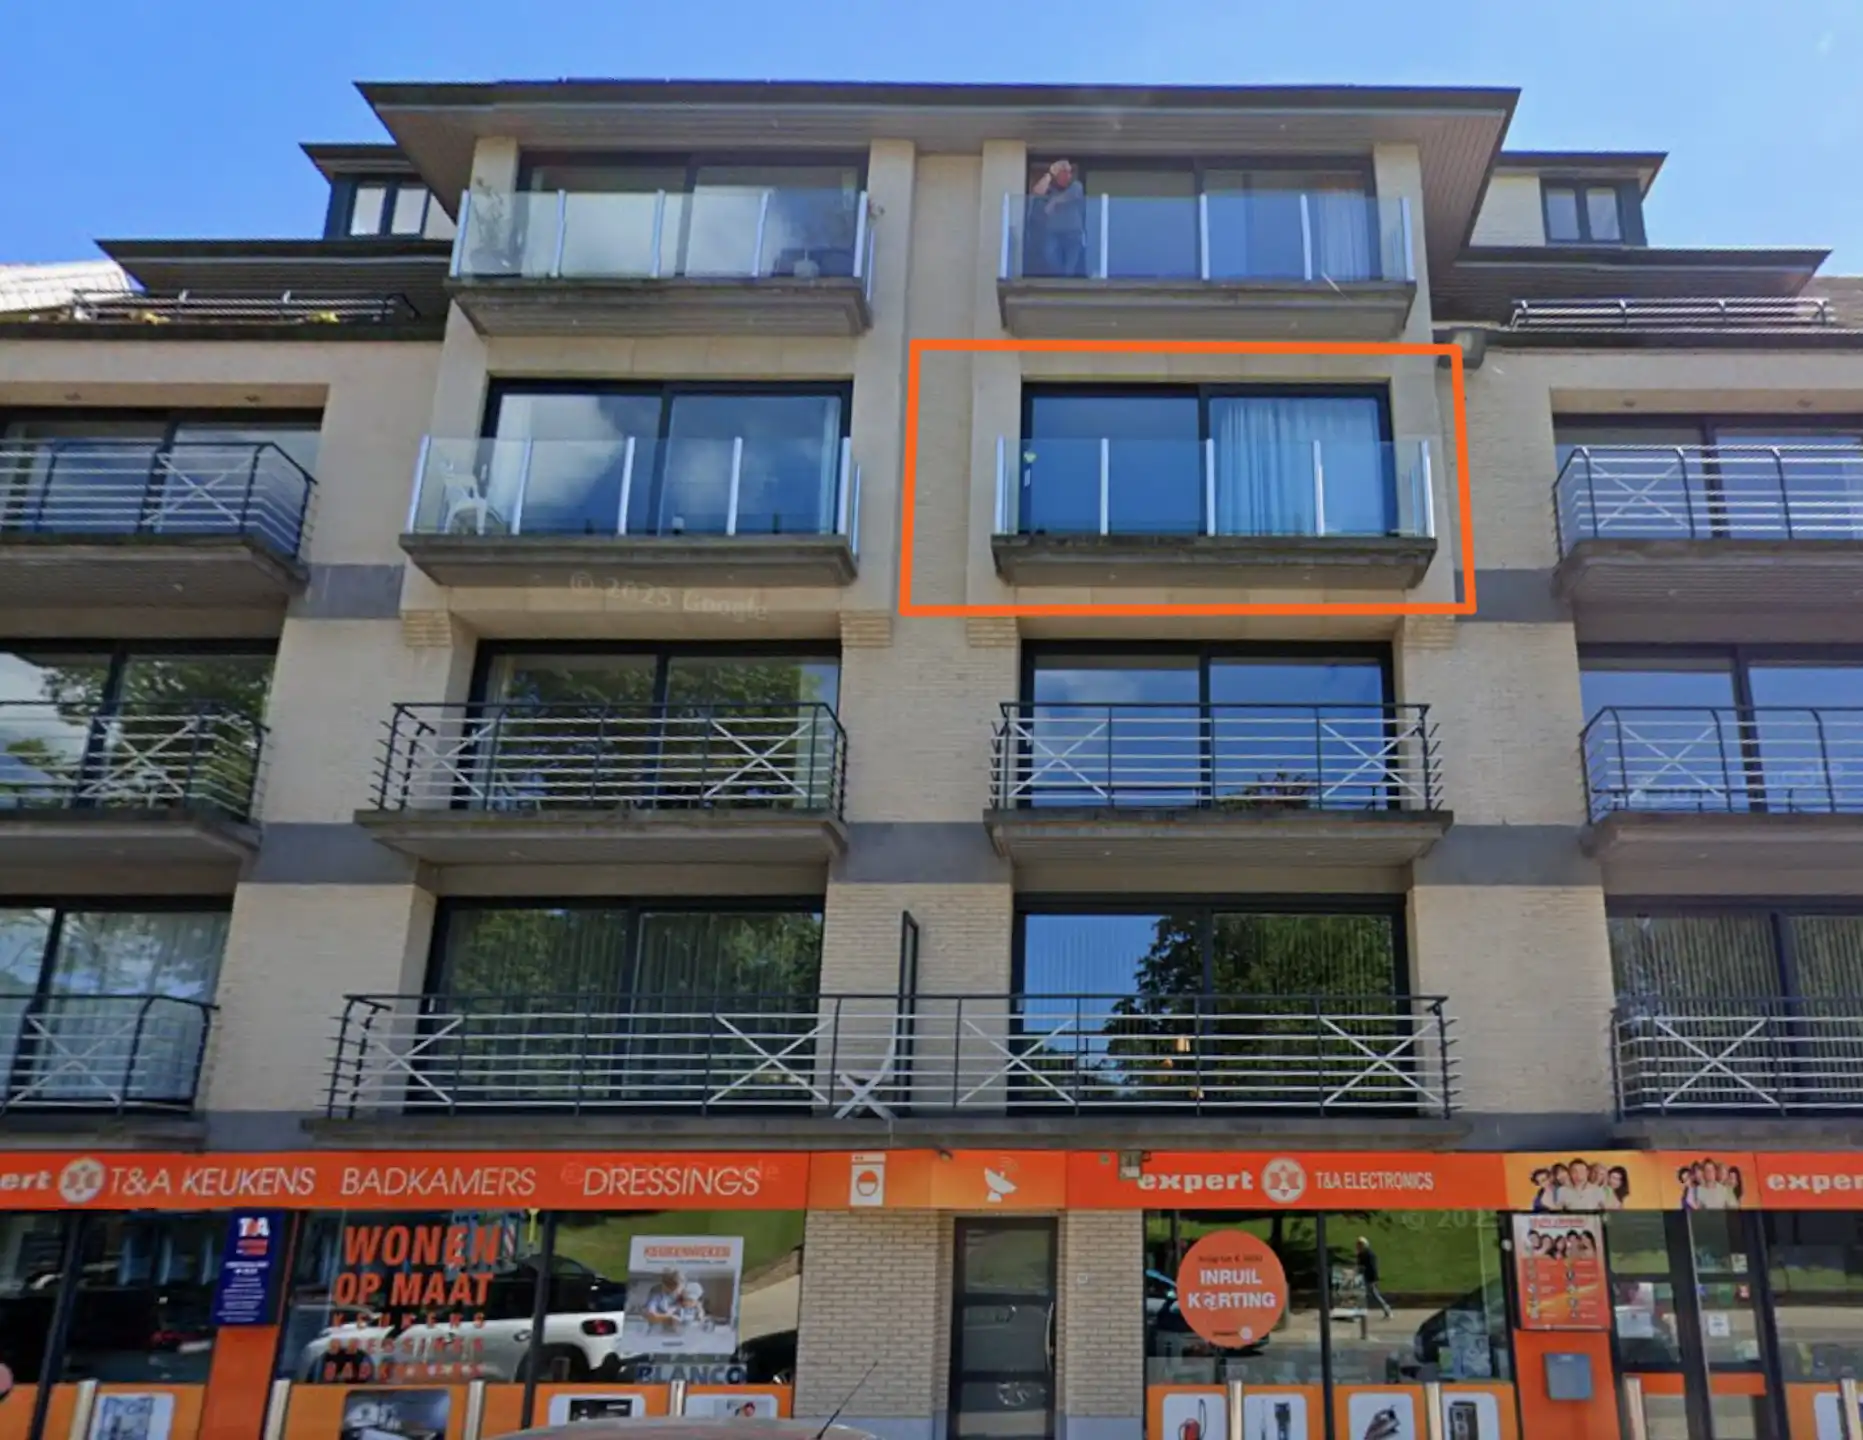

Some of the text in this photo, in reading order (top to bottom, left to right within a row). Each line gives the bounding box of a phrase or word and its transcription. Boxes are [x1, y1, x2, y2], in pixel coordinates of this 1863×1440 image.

[111, 1167, 171, 1195] T&A
[181, 1167, 316, 1195] KEUKENS
[340, 1167, 536, 1196] BADKAMERS
[583, 1167, 760, 1196] DRESSINGS
[1137, 1170, 1254, 1194] expert
[1316, 1171, 1434, 1190] T&A ELECTRONICS
[344, 1225, 502, 1266] WONEN
[334, 1272, 494, 1306] OP MAAT
[1200, 1268, 1262, 1285] INRUIL
